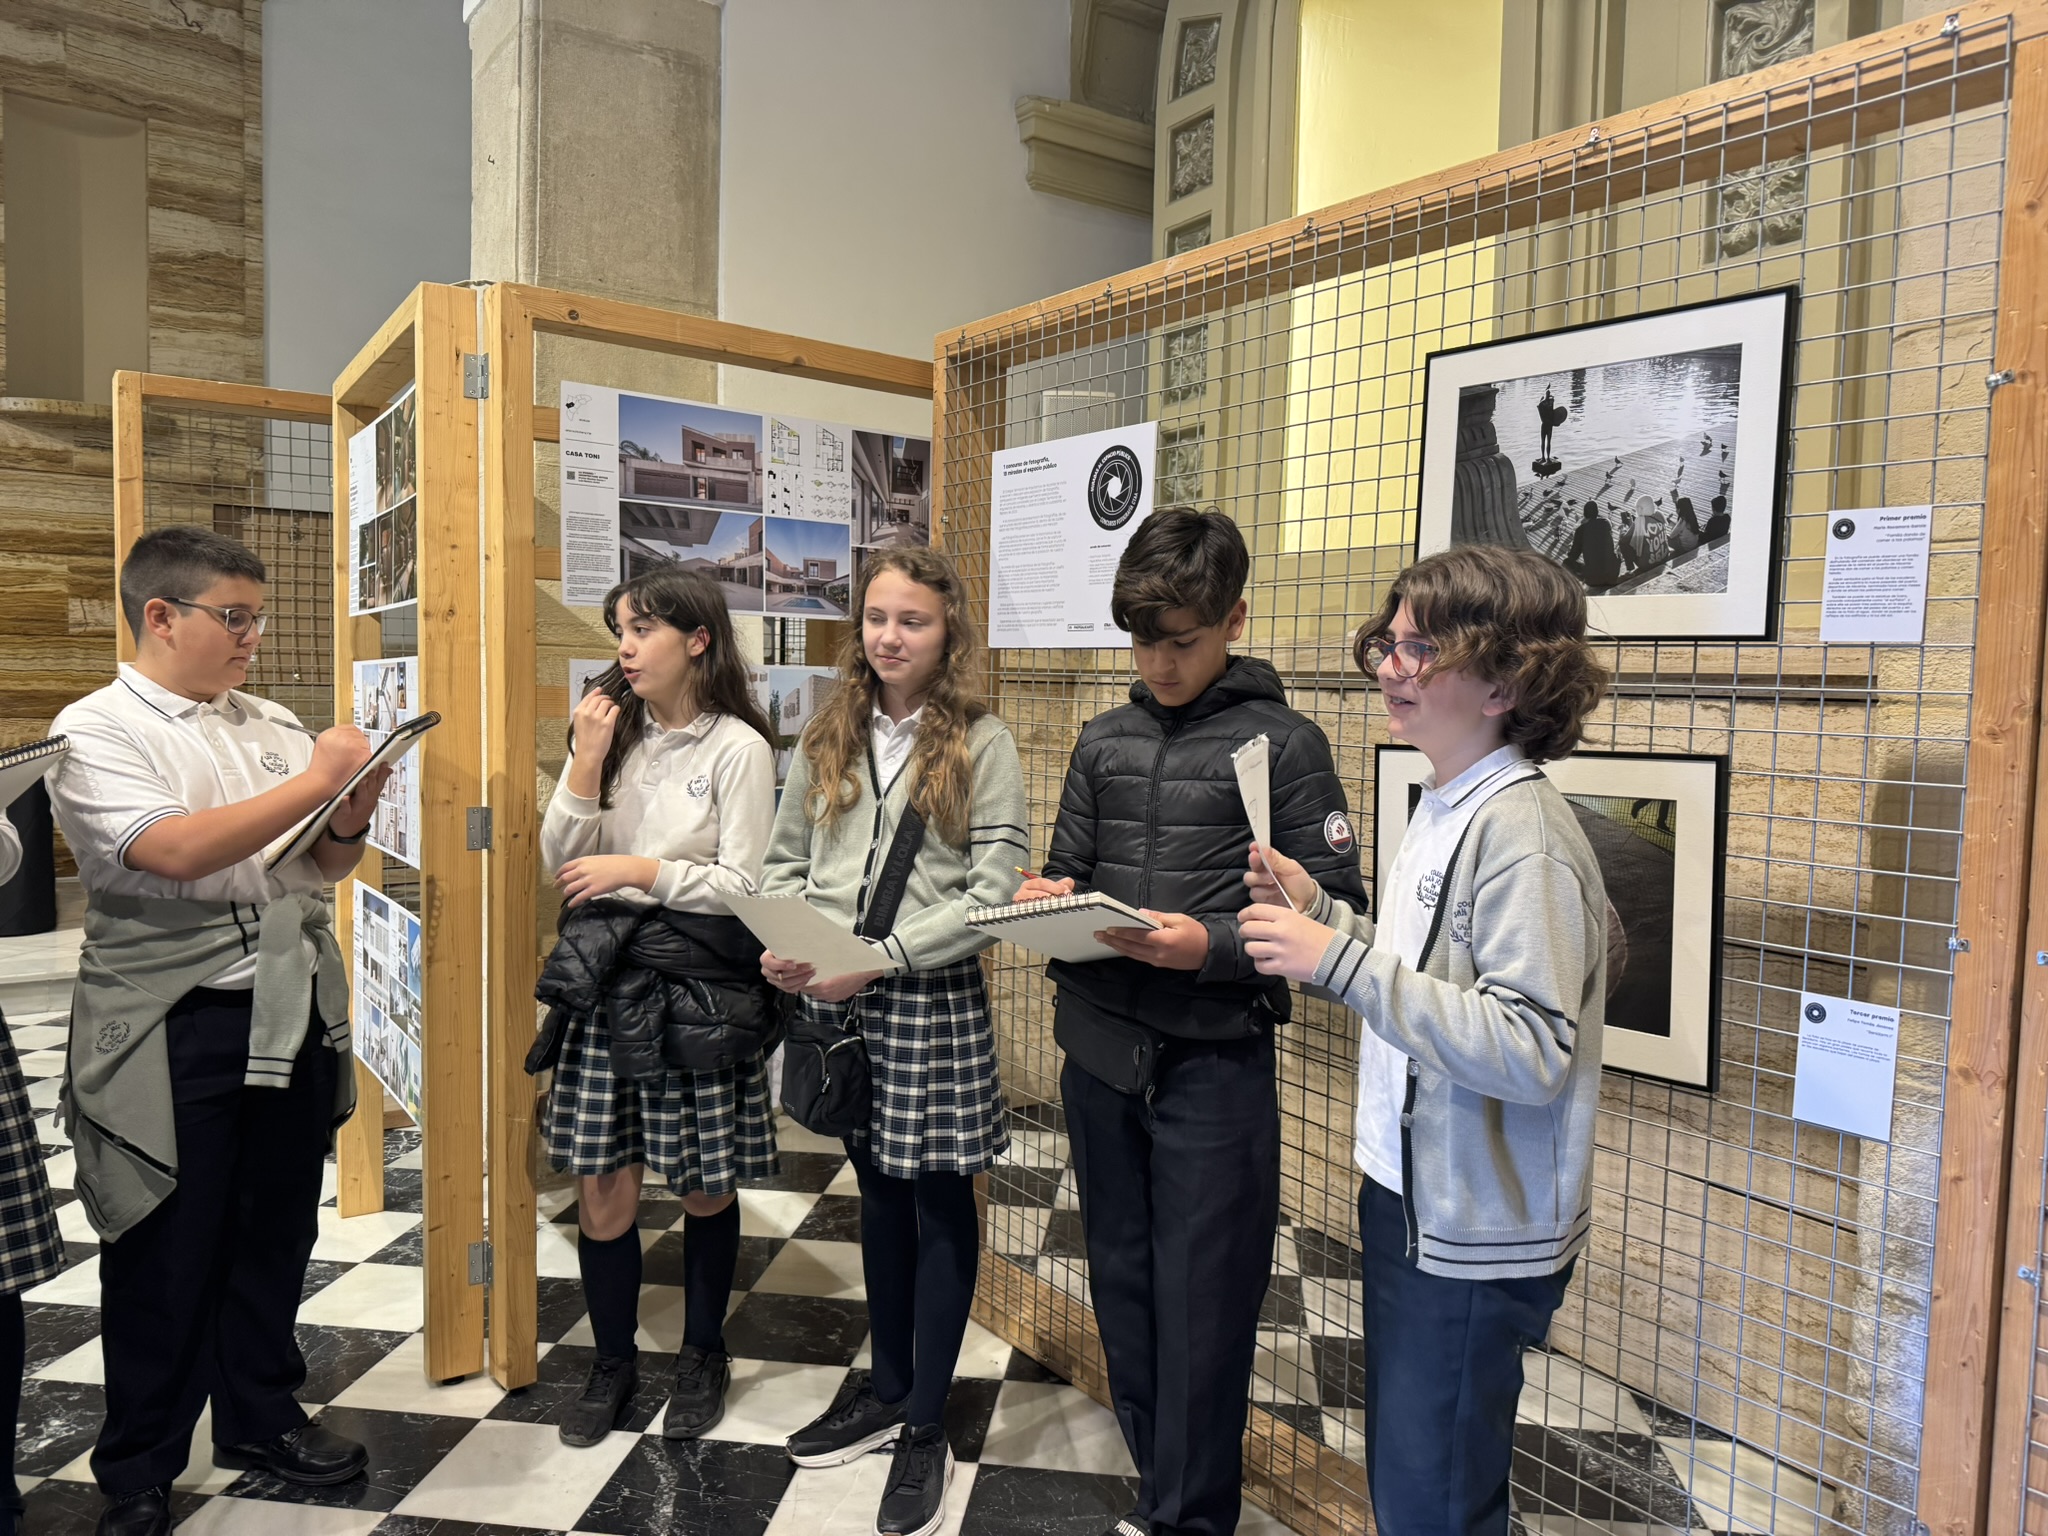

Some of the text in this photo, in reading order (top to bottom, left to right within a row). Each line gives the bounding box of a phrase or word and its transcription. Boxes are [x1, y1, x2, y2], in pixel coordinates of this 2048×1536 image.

[566, 450, 601, 460] CASA TONI
[1006, 462, 1023, 470] concurso
[1027, 465, 1043, 473] espacio
[1042, 462, 1058, 471] público
[1902, 513, 1927, 522] premio
[874, 830, 916, 928] BIMBA Y LOLA
[1850, 1009, 1895, 1023] Tercer premio
